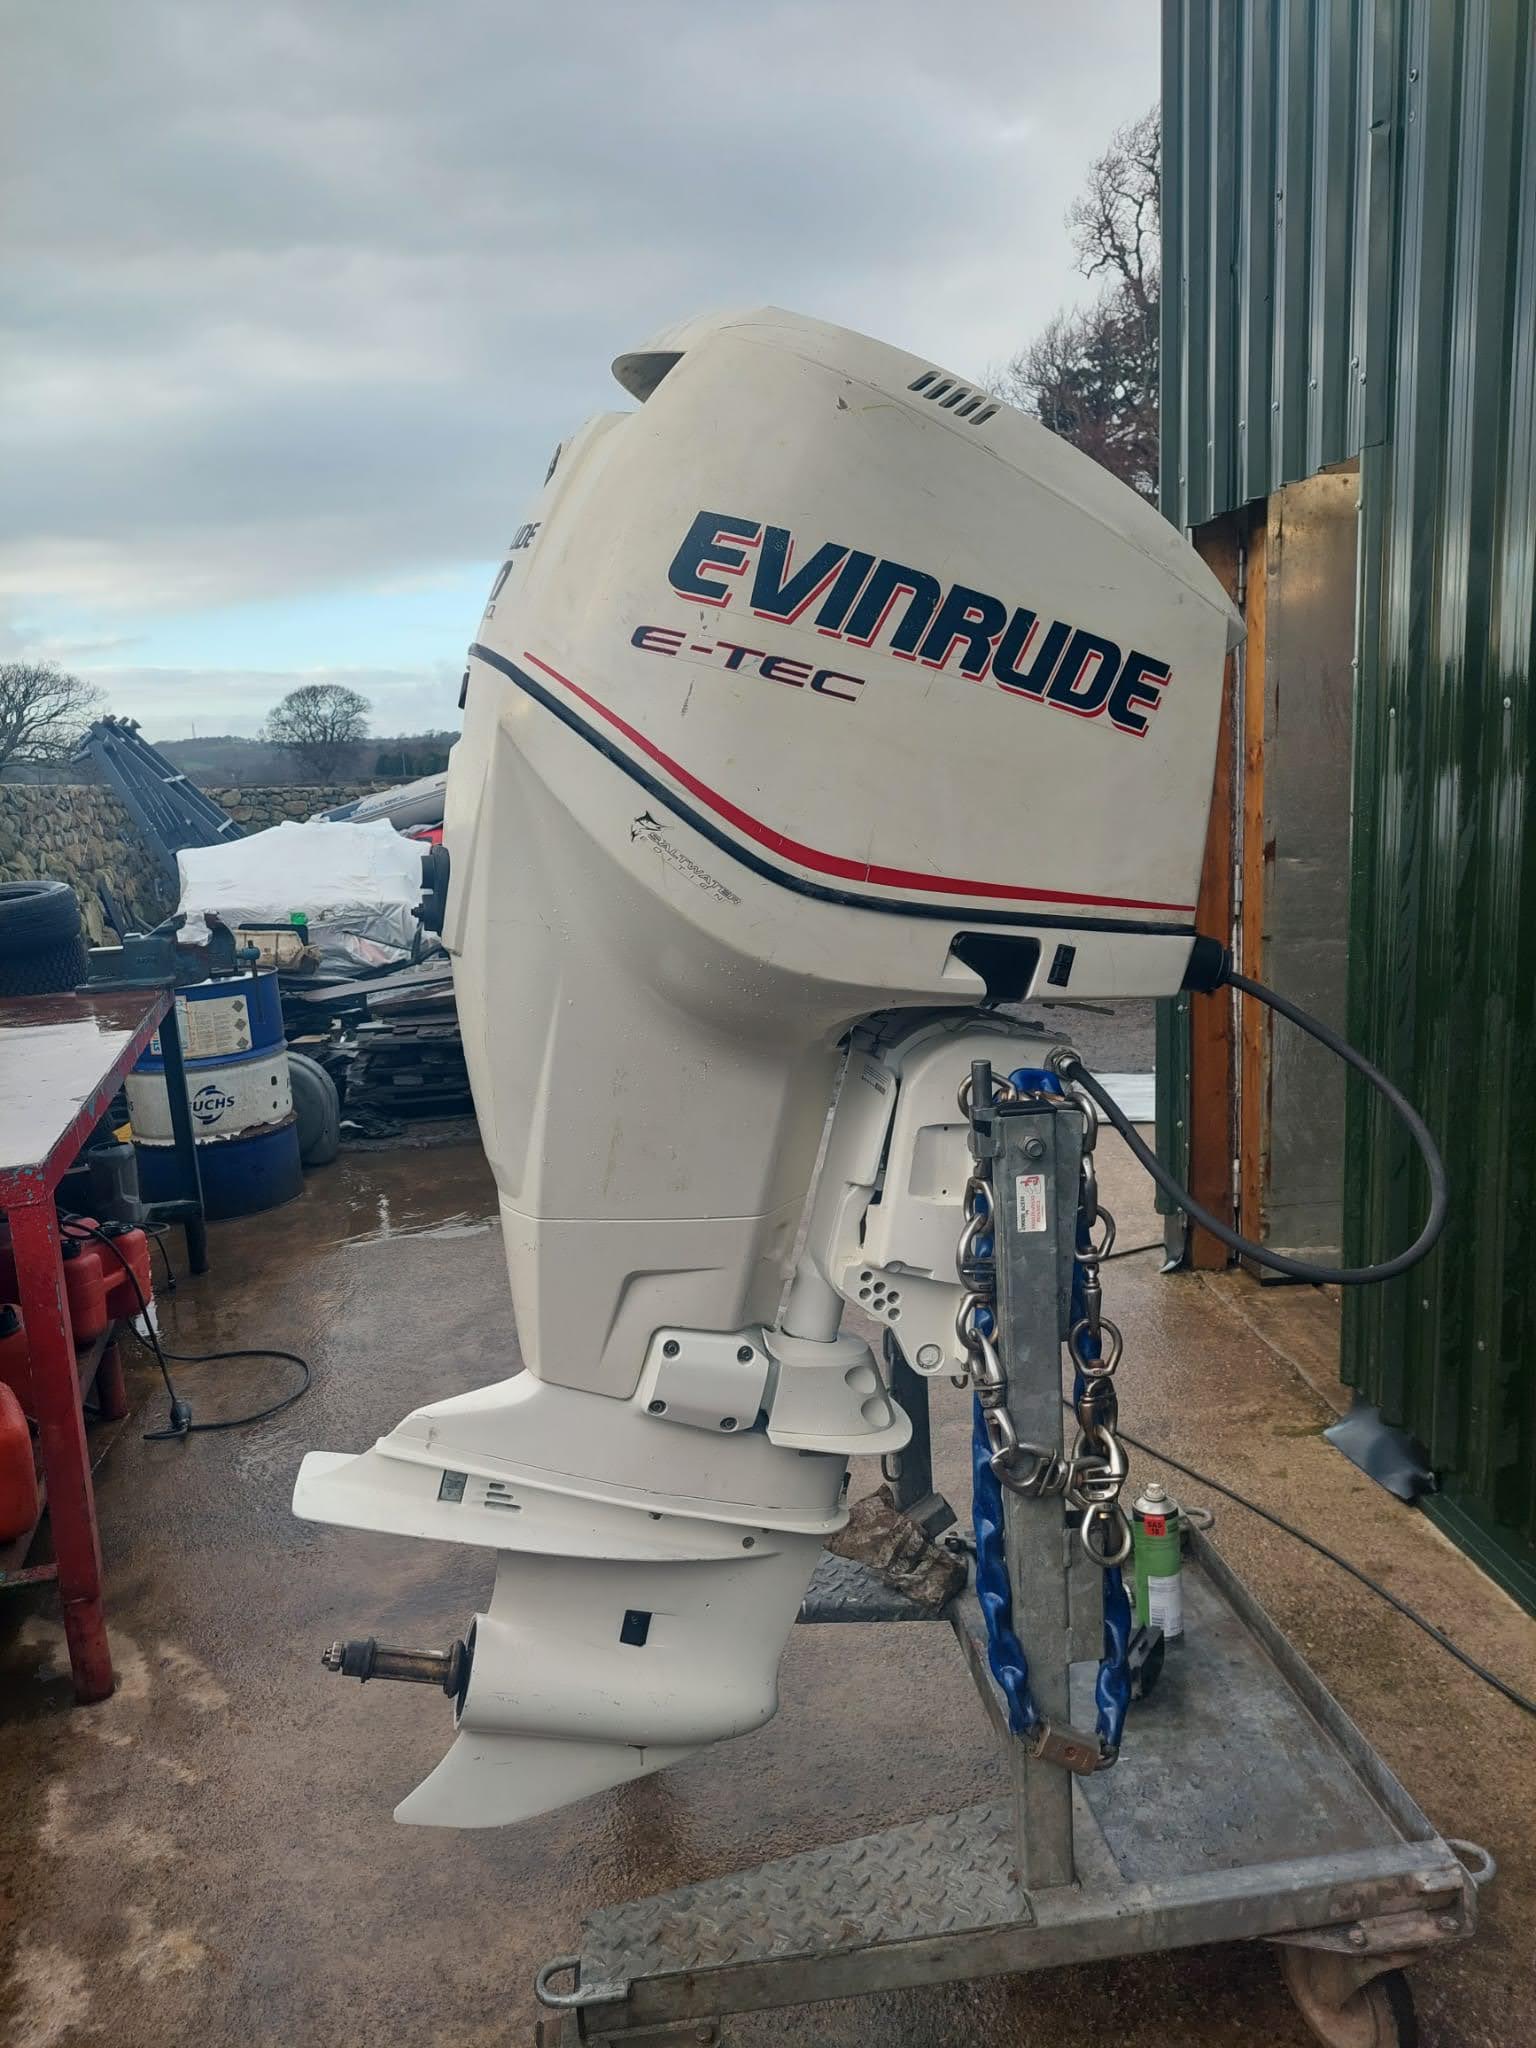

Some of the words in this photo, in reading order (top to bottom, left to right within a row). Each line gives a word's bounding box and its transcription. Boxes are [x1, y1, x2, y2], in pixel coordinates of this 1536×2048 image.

[668, 510, 1173, 738] EVINRUDE
[630, 625, 866, 702] E-TEC
[648, 832, 741, 904] SALTWATER
[189, 1096, 235, 1112] UCHS
